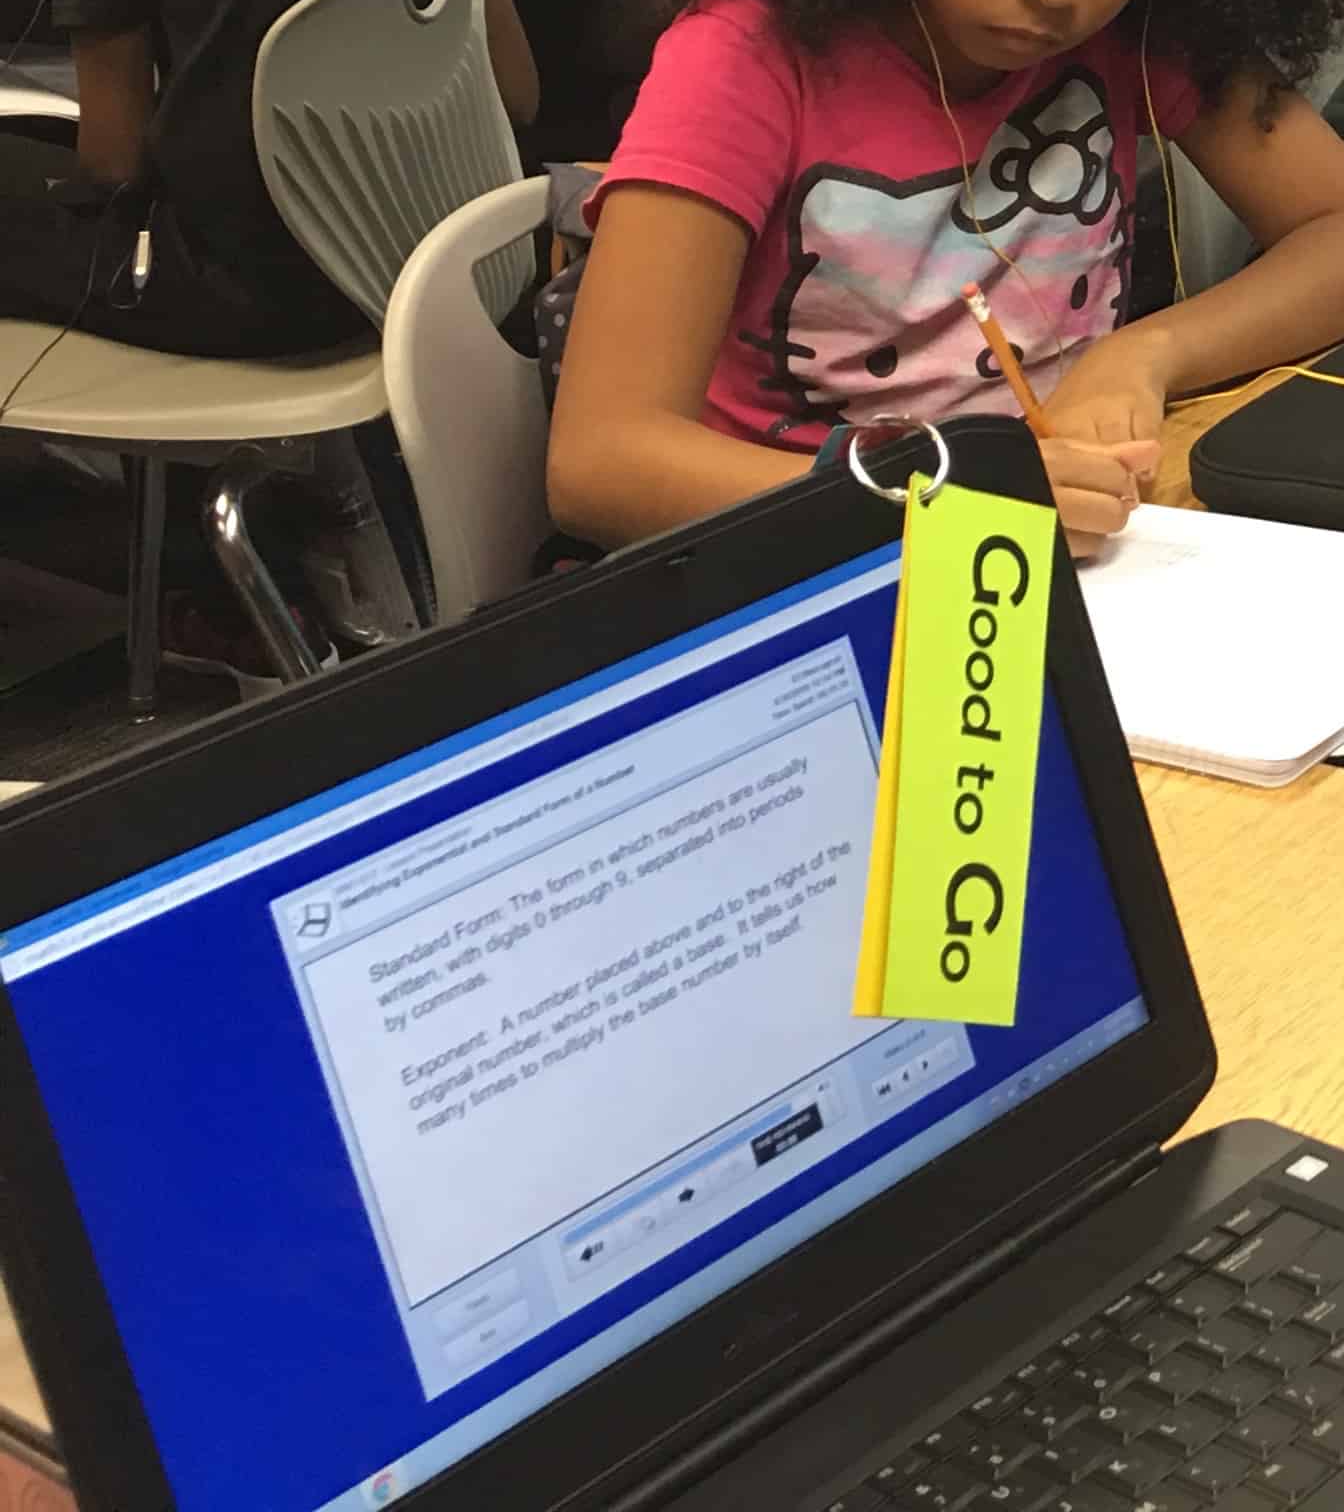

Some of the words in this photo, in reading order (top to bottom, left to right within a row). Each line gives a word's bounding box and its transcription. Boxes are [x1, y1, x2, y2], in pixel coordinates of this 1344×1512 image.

[961, 534, 1030, 742] Good
[953, 763, 994, 835] to
[366, 929, 452, 985] Standard
[451, 903, 504, 943] Form:
[507, 884, 544, 915] The
[544, 863, 587, 897] form
[585, 854, 606, 877] in
[605, 829, 655, 867] which
[654, 795, 726, 842] numbers
[725, 781, 754, 807] are
[753, 754, 810, 796] usually
[939, 862, 1004, 983] Go
[382, 1009, 409, 1038] by
[409, 967, 491, 1021] commas.
